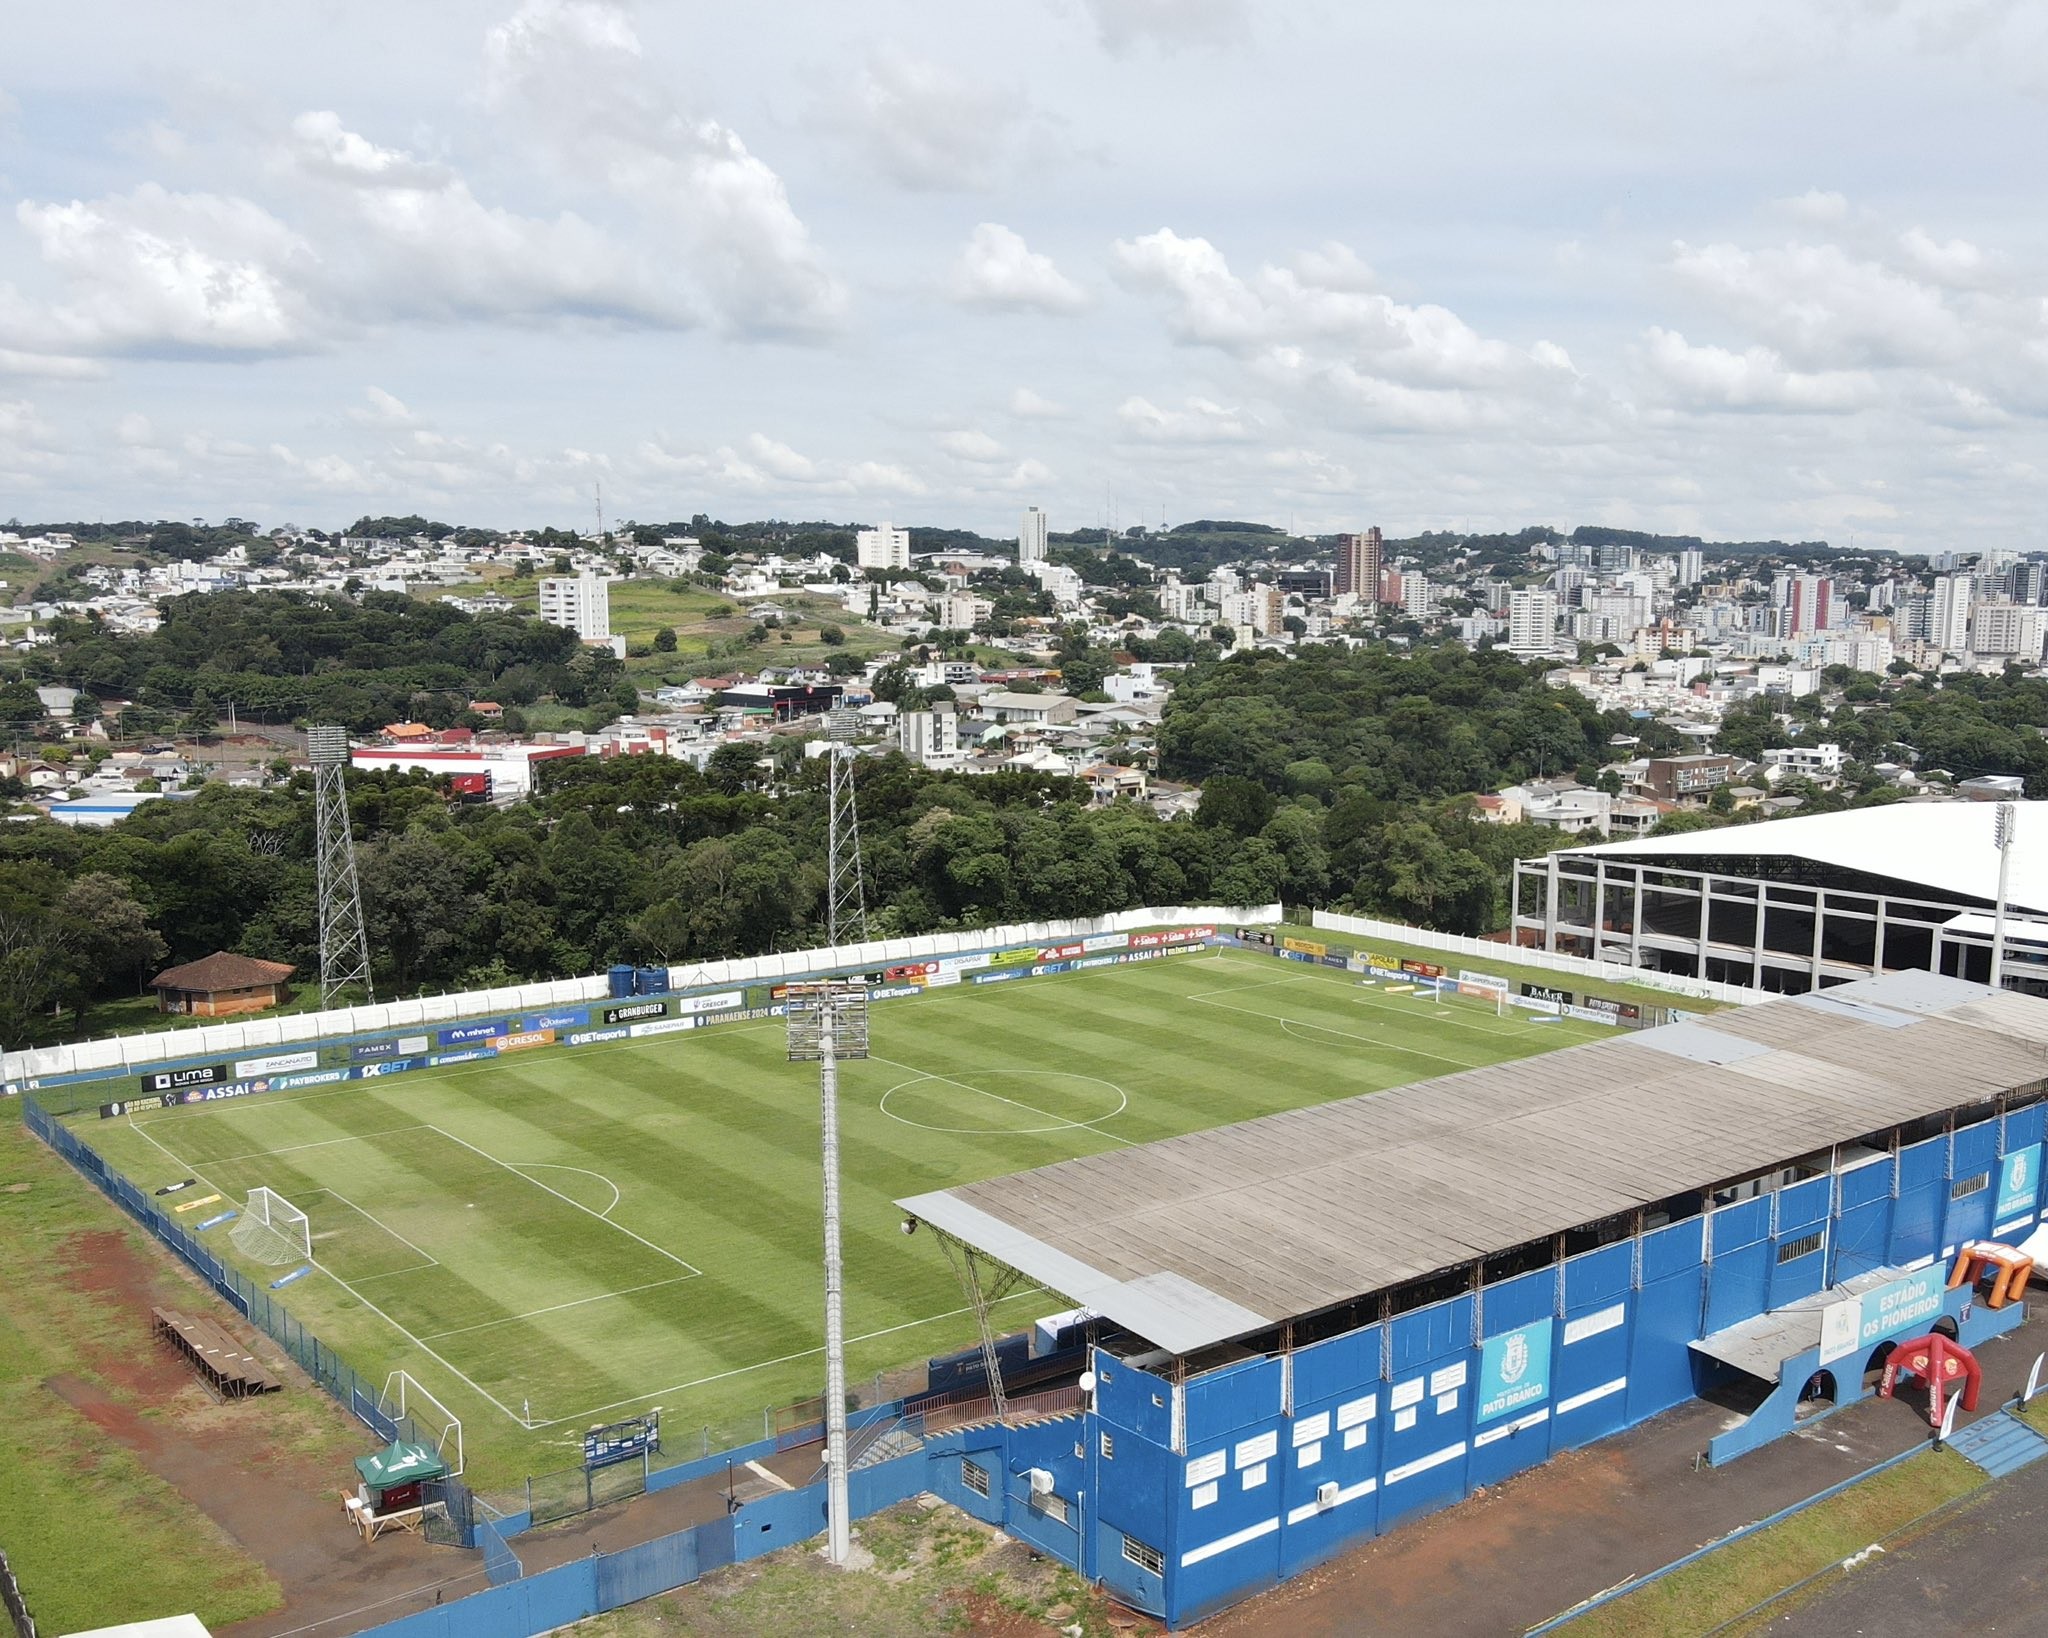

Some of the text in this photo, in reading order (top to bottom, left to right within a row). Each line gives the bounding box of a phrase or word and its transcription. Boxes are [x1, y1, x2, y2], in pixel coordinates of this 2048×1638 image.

[618, 1003, 663, 1019] GRANBURGER
[706, 1010, 751, 1026] PARANAENSE
[751, 1007, 769, 1019] 2024
[508, 1032, 545, 1046] CRESOL
[580, 1029, 627, 1043] BETesporte
[361, 1059, 411, 1077] 1XBET
[289, 1071, 340, 1086] PAYBROKERS
[1879, 1281, 1927, 1313] ESTÁDIO
[1863, 1294, 1939, 1338] OS PIONEIROS
[1482, 1400, 1505, 1416] PATO
[1506, 1383, 1543, 1406] BRANCO
